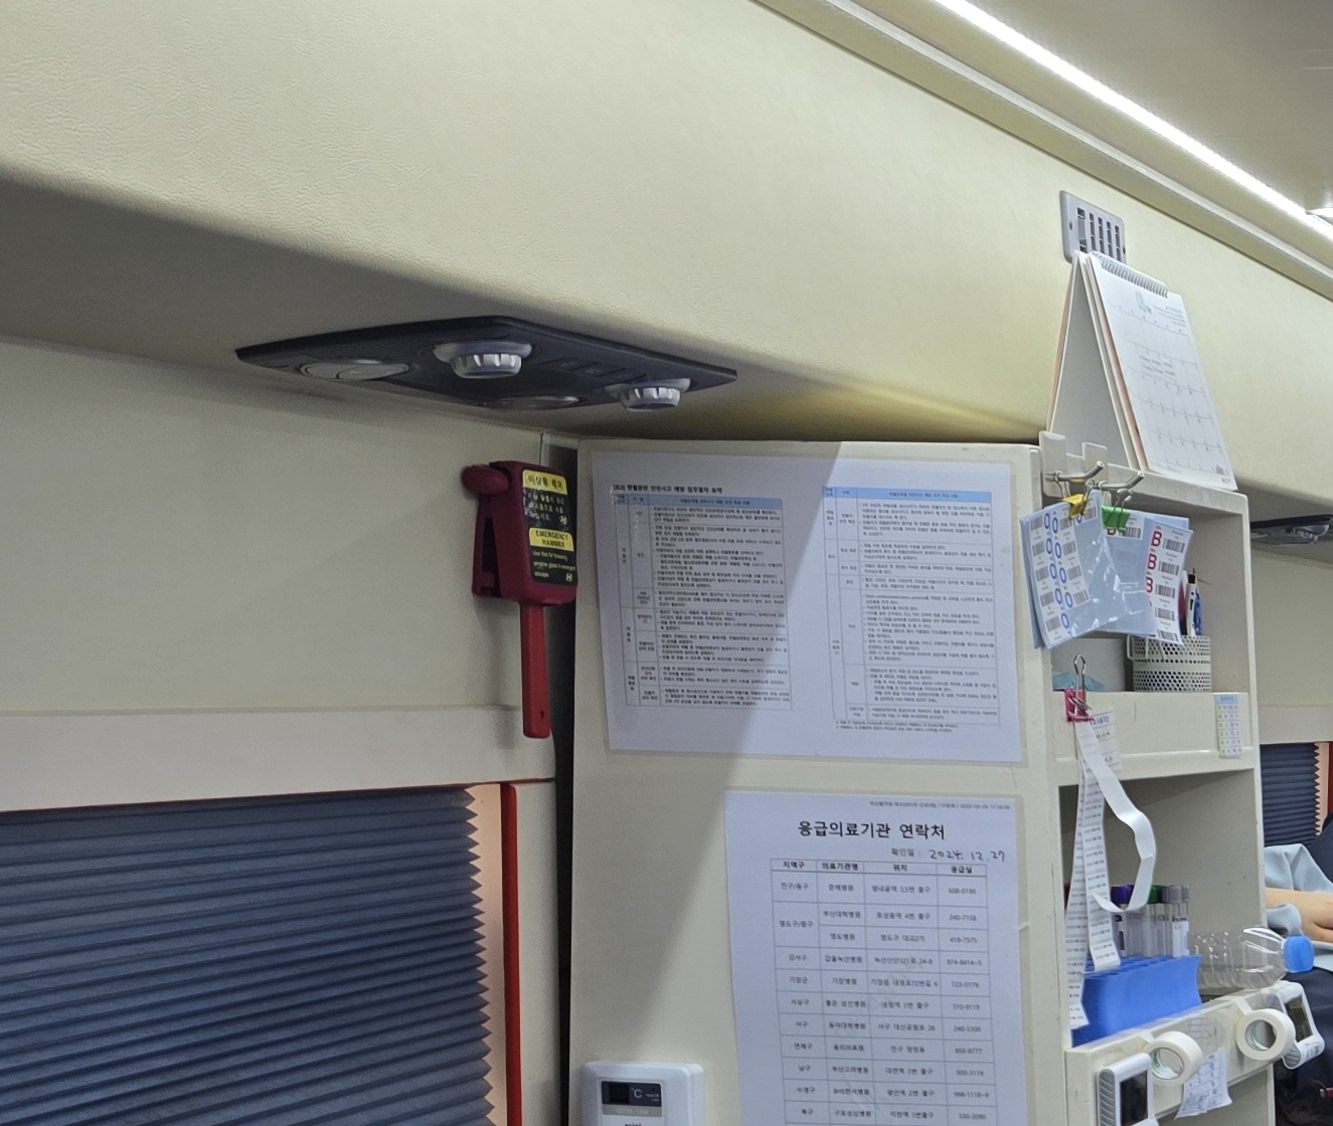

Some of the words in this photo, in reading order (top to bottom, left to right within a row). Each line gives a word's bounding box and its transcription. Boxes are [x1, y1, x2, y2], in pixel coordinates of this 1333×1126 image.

[535, 530, 568, 540] EMERGENCY
[1151, 530, 1162, 547] B
[1147, 553, 1157, 570] B
[798, 820, 891, 839] 응급의료기관
[899, 823, 946, 840] 연락처
[782, 860, 805, 869] 지역구
[821, 861, 859, 872] 의료기관명
